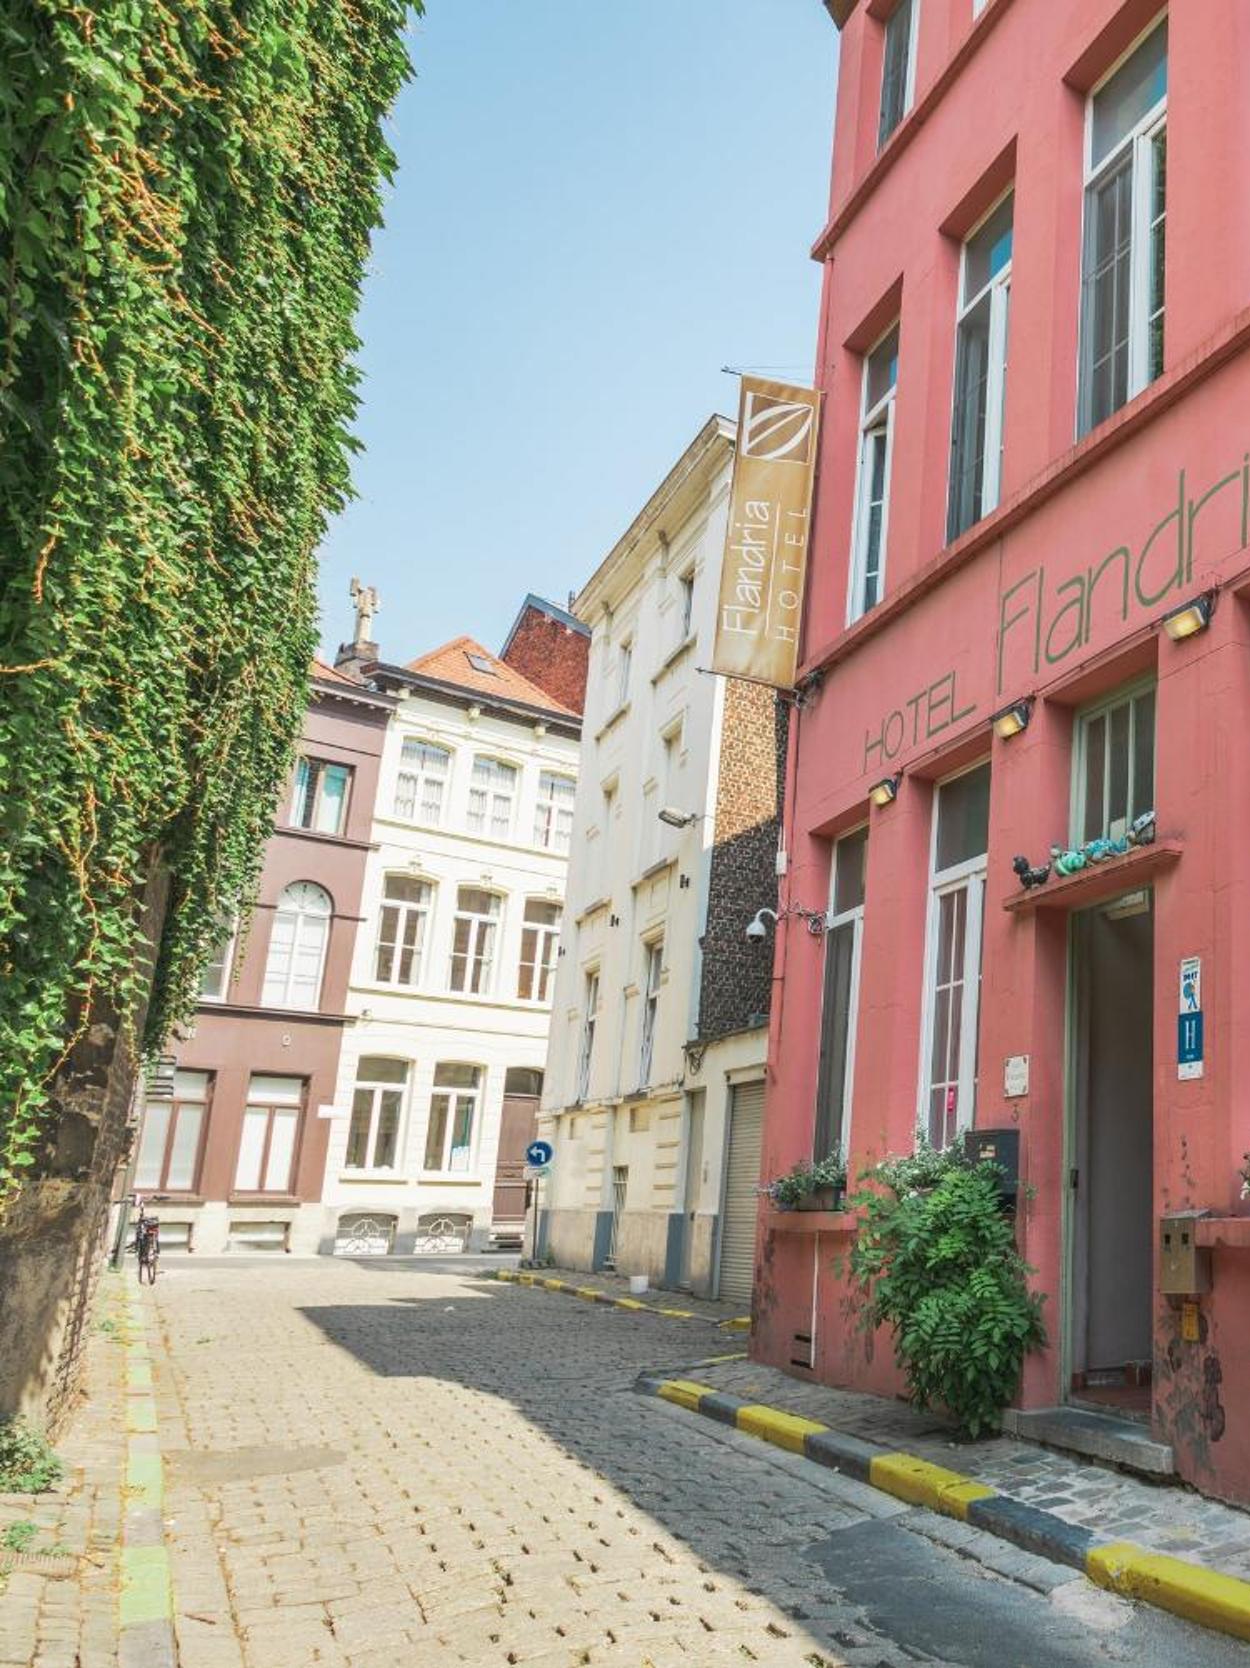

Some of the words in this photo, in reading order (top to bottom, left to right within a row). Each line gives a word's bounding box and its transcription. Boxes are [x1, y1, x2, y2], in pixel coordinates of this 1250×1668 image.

[723, 499, 771, 637] Flandria
[775, 507, 809, 643] HOTEL
[863, 671, 978, 774] HOTEL
[1185, 1019, 1197, 1049] H
